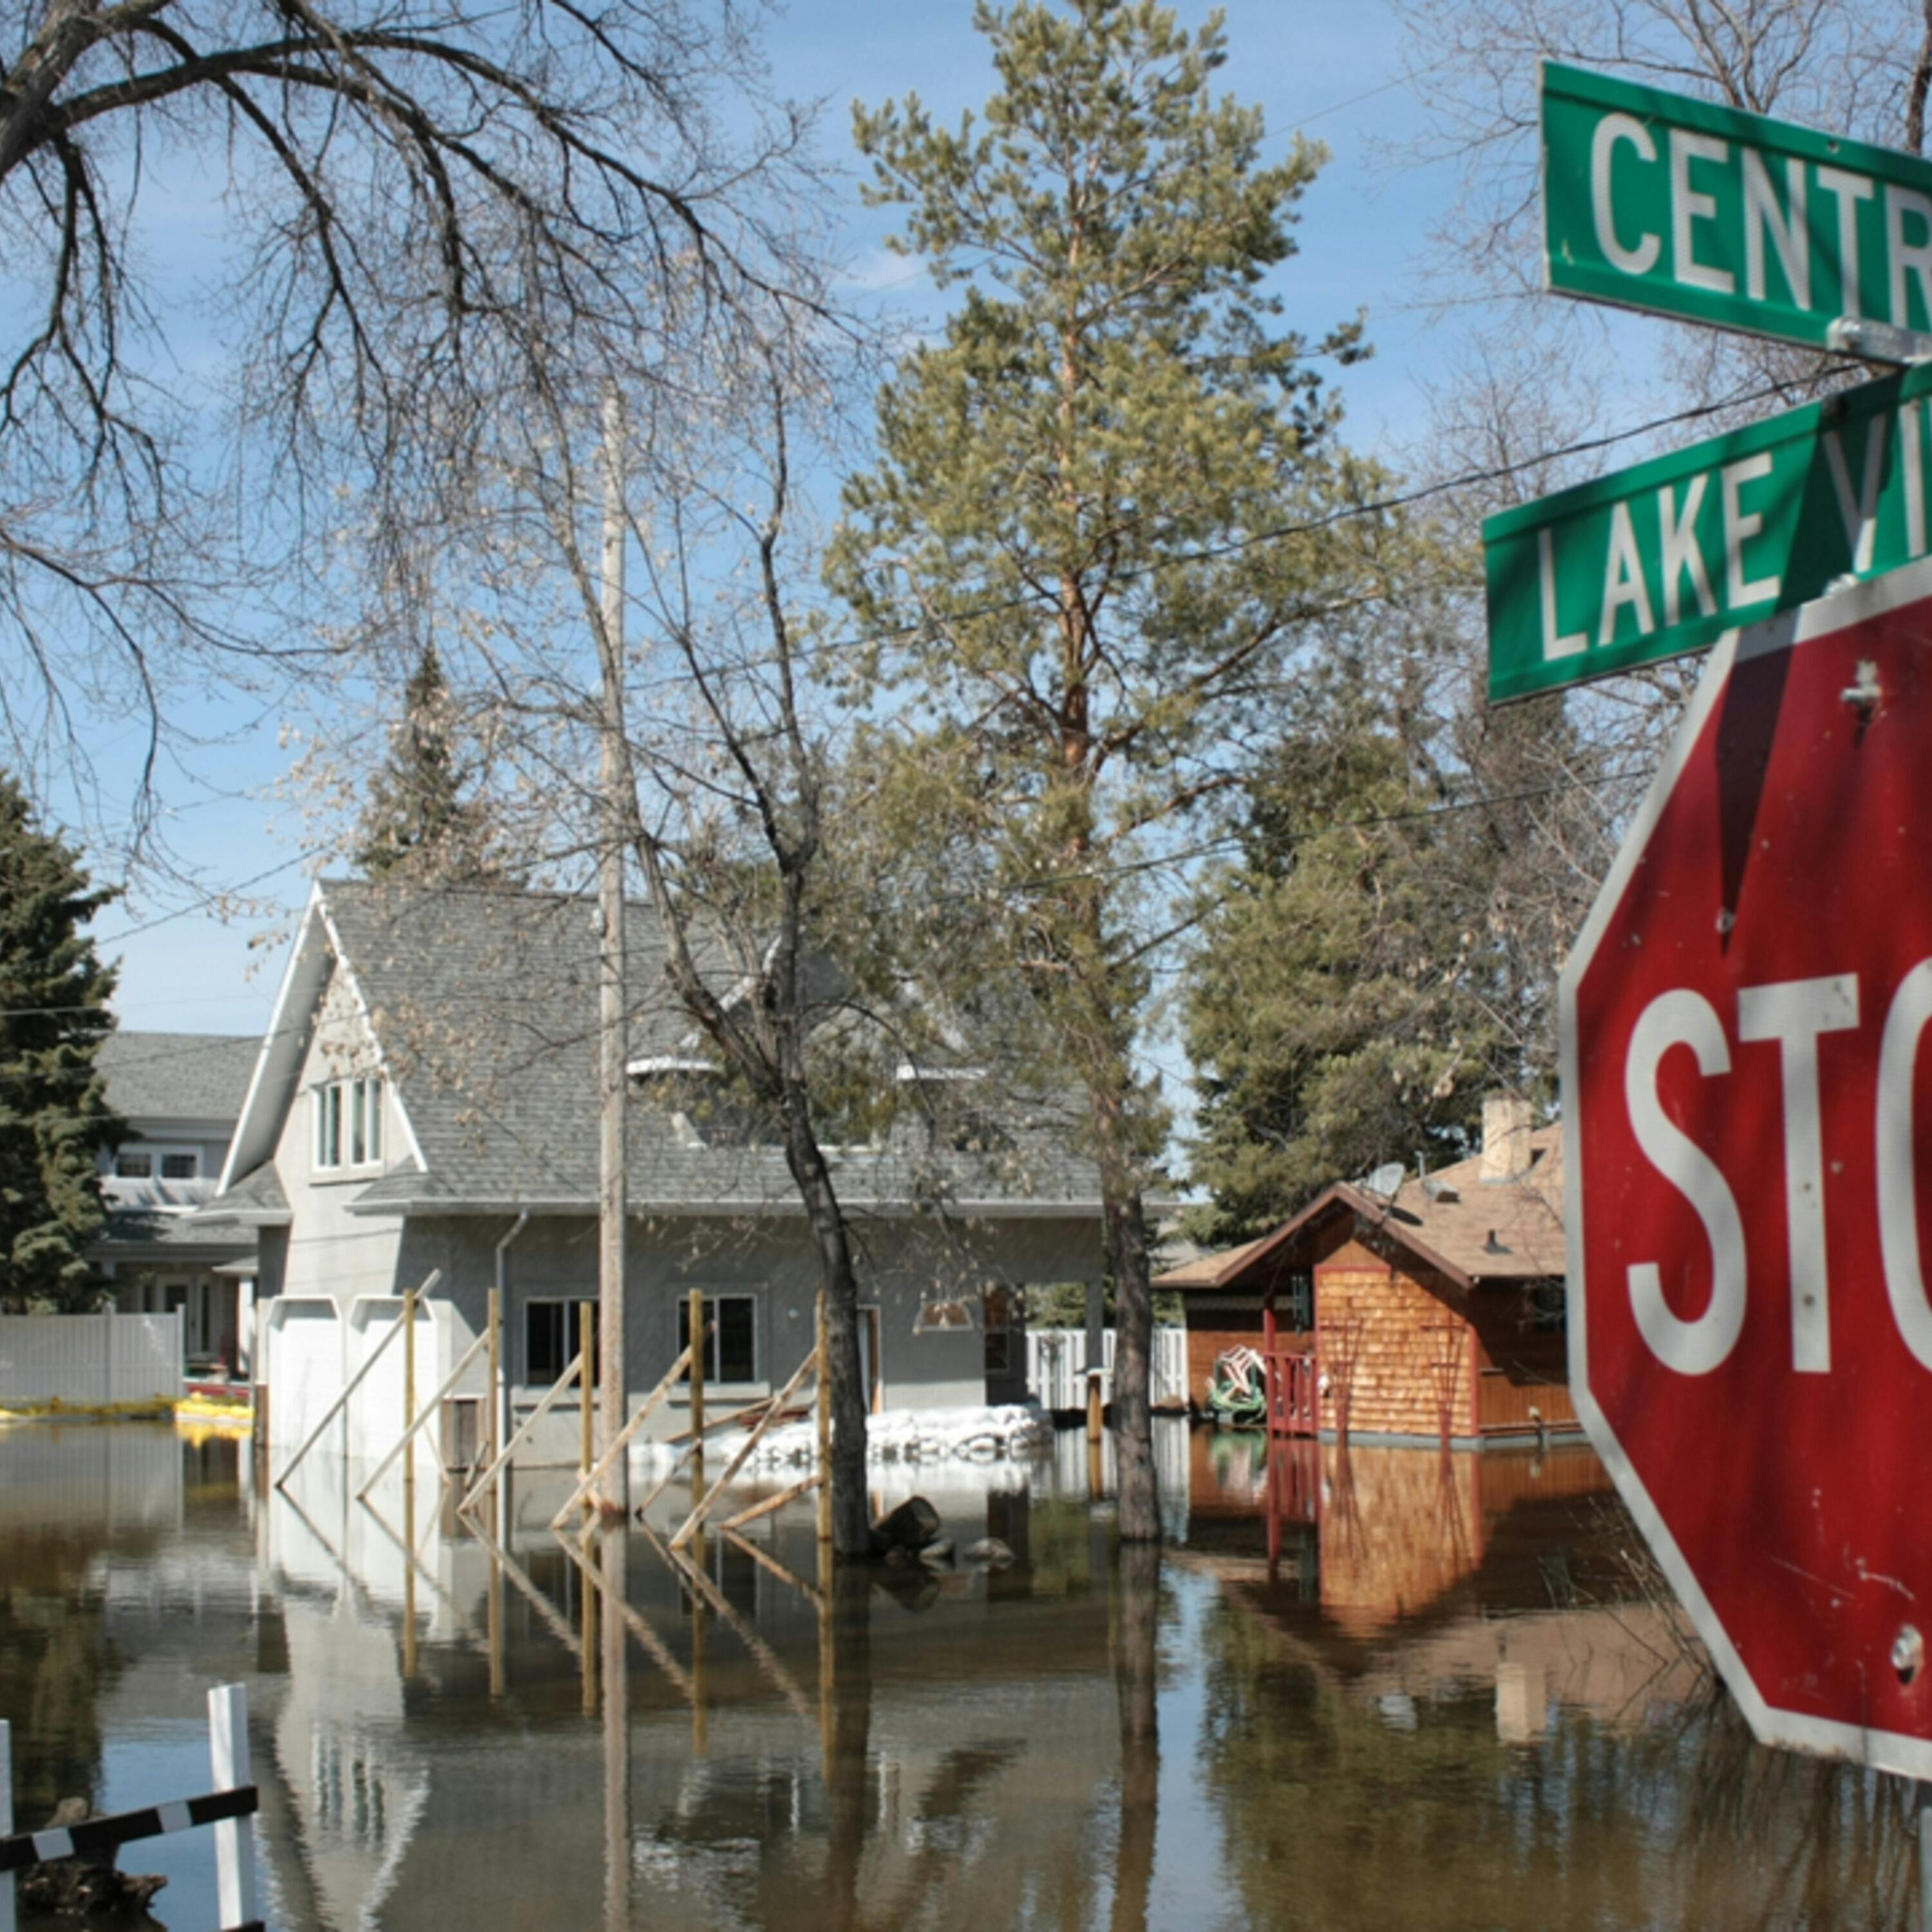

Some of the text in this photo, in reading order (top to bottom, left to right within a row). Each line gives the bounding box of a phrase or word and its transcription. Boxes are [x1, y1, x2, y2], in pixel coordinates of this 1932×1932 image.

[1591, 112, 1932, 332] CENTR
[1538, 395, 1932, 661] LAKE VI
